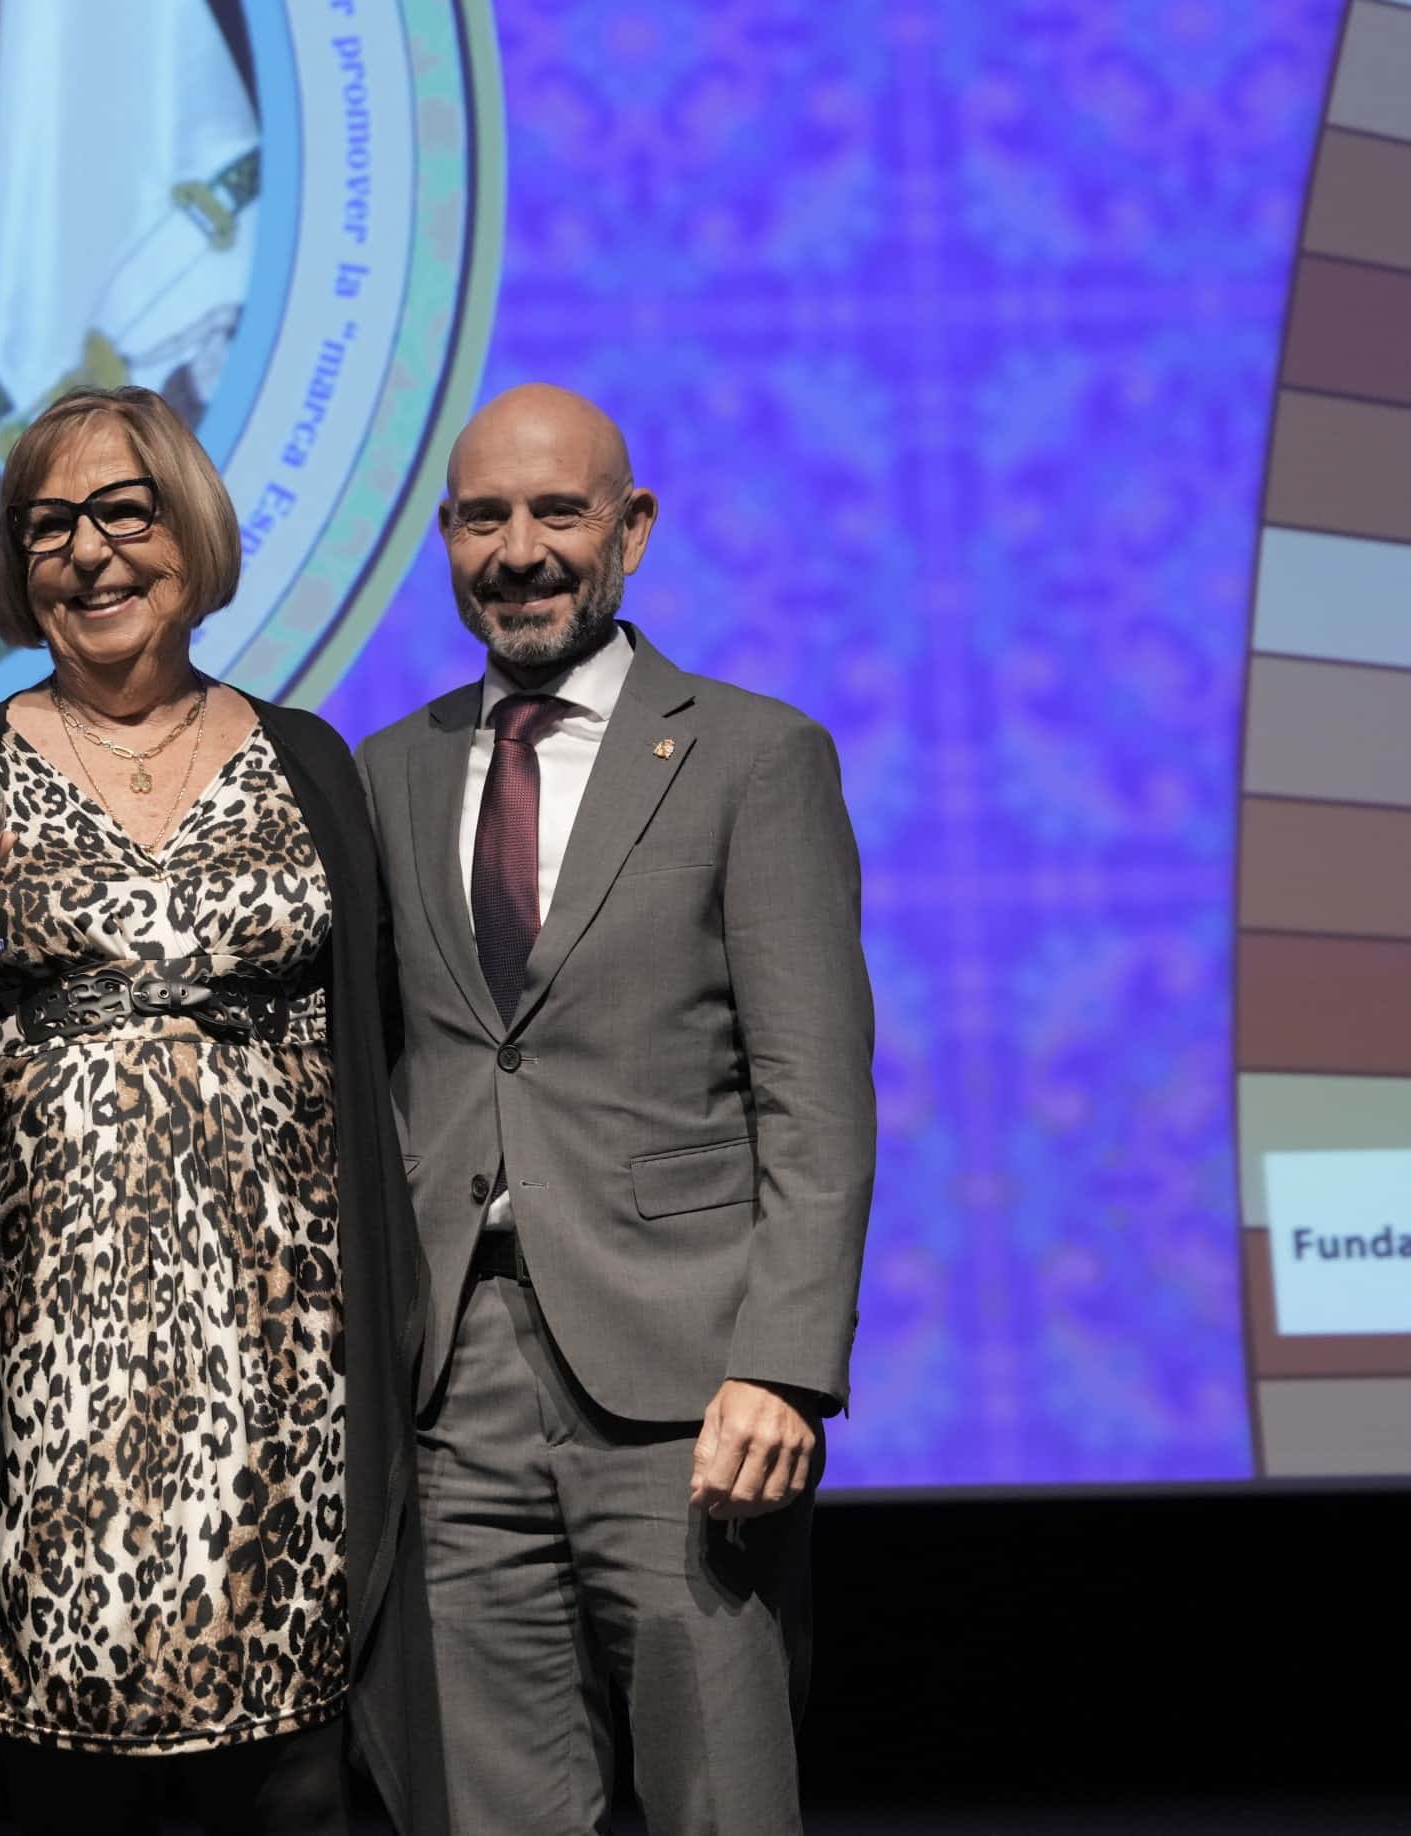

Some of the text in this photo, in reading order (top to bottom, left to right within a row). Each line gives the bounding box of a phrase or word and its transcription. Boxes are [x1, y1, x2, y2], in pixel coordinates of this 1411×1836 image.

[331, 35, 372, 245] promover
[333, 262, 370, 300] la
[240, 481, 298, 568] Esp
[1291, 1225, 1411, 1261] Funda
